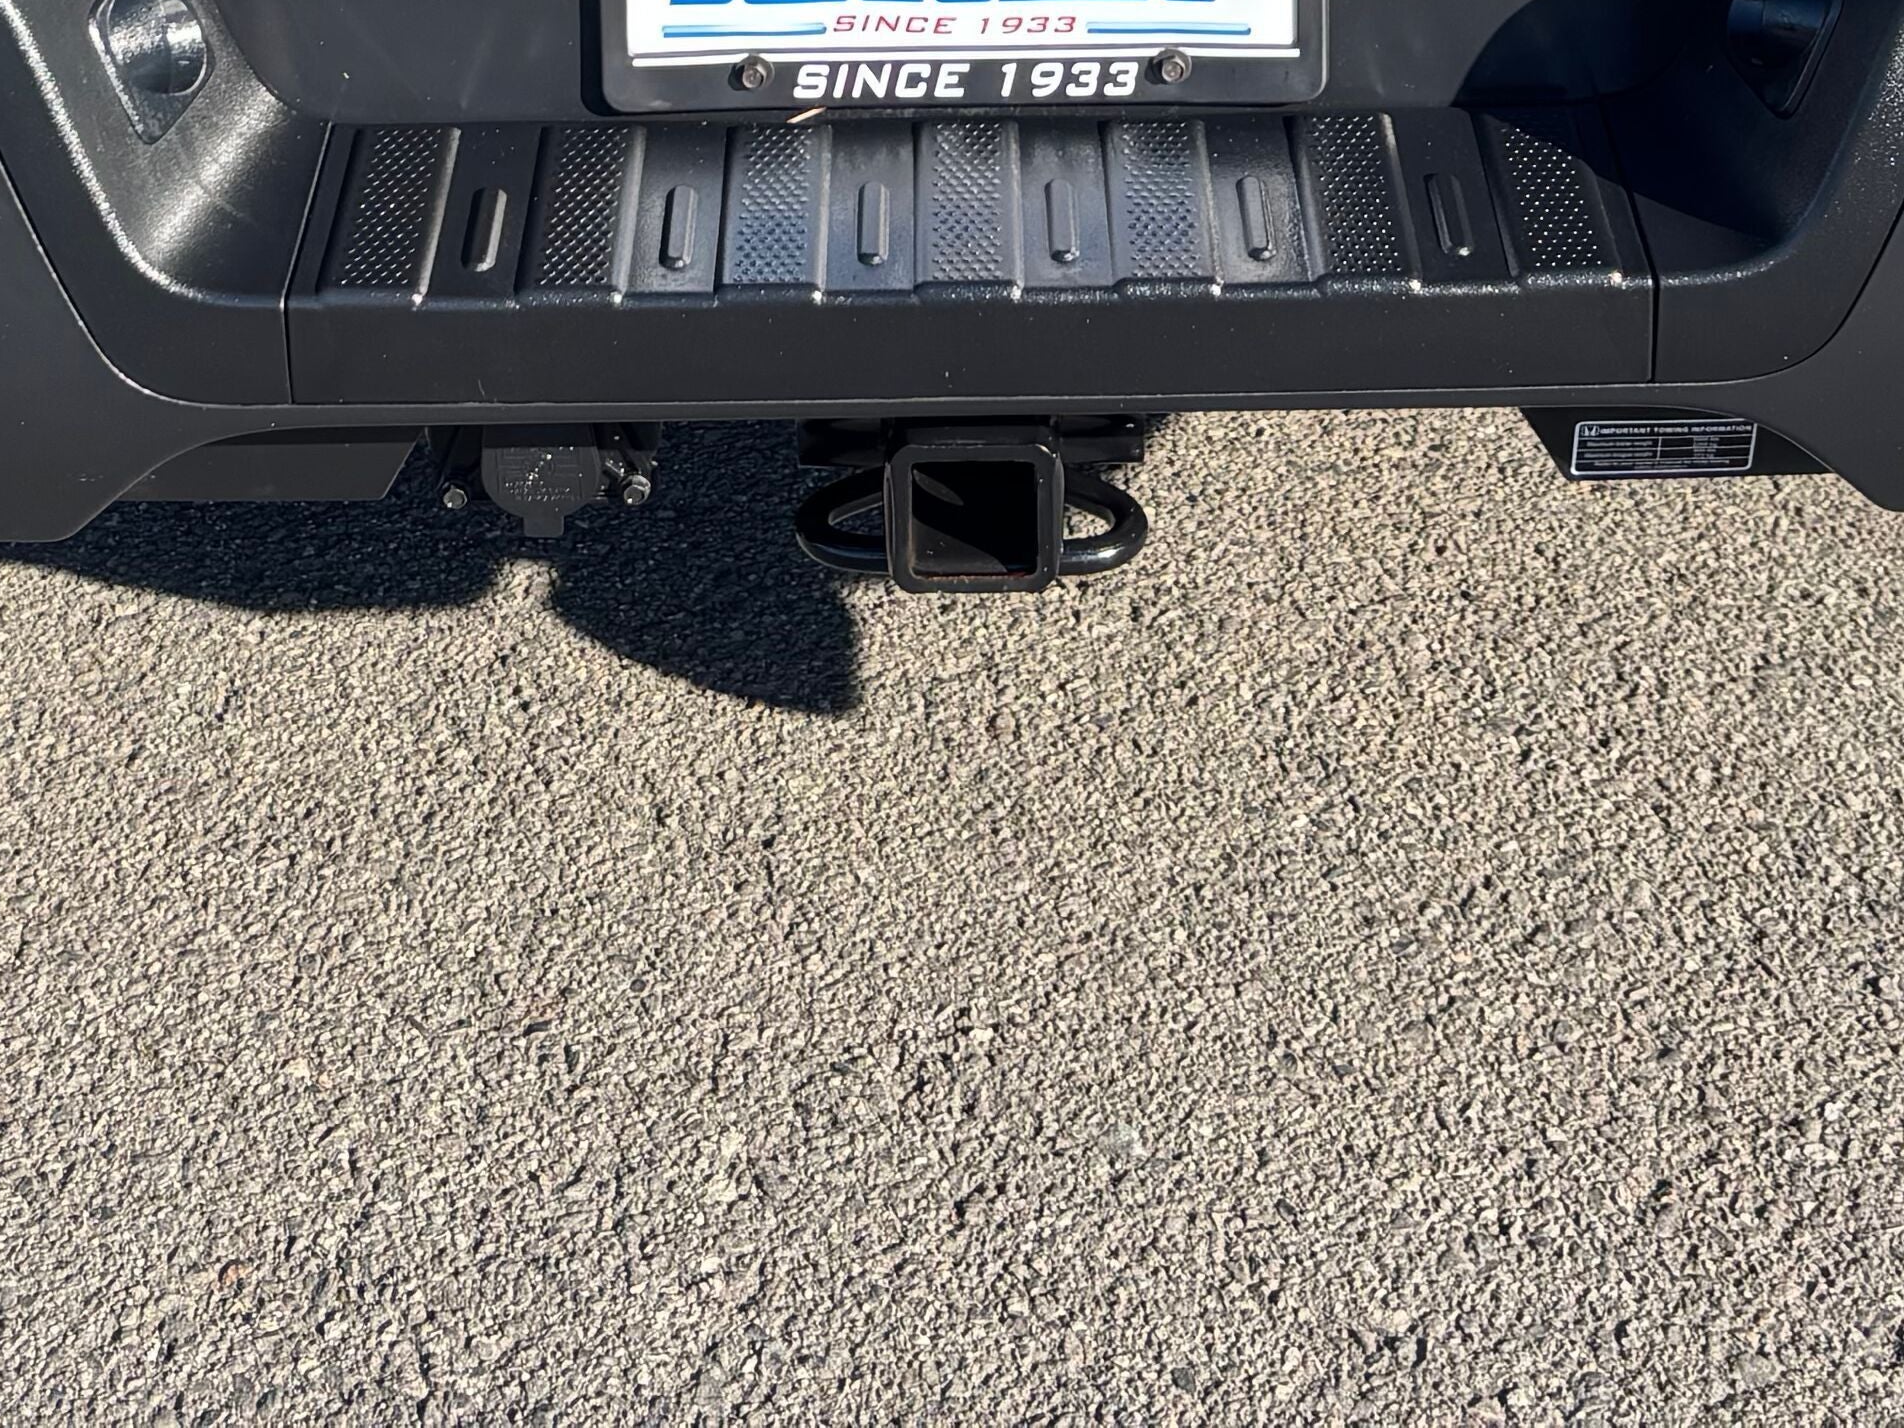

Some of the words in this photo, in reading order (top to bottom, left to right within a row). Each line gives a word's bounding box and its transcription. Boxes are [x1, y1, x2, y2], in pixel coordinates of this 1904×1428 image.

[832, 16, 957, 36] SINCE
[977, 15, 1078, 35] 1933
[792, 64, 970, 100] SINCE
[999, 62, 1138, 98] 1933
